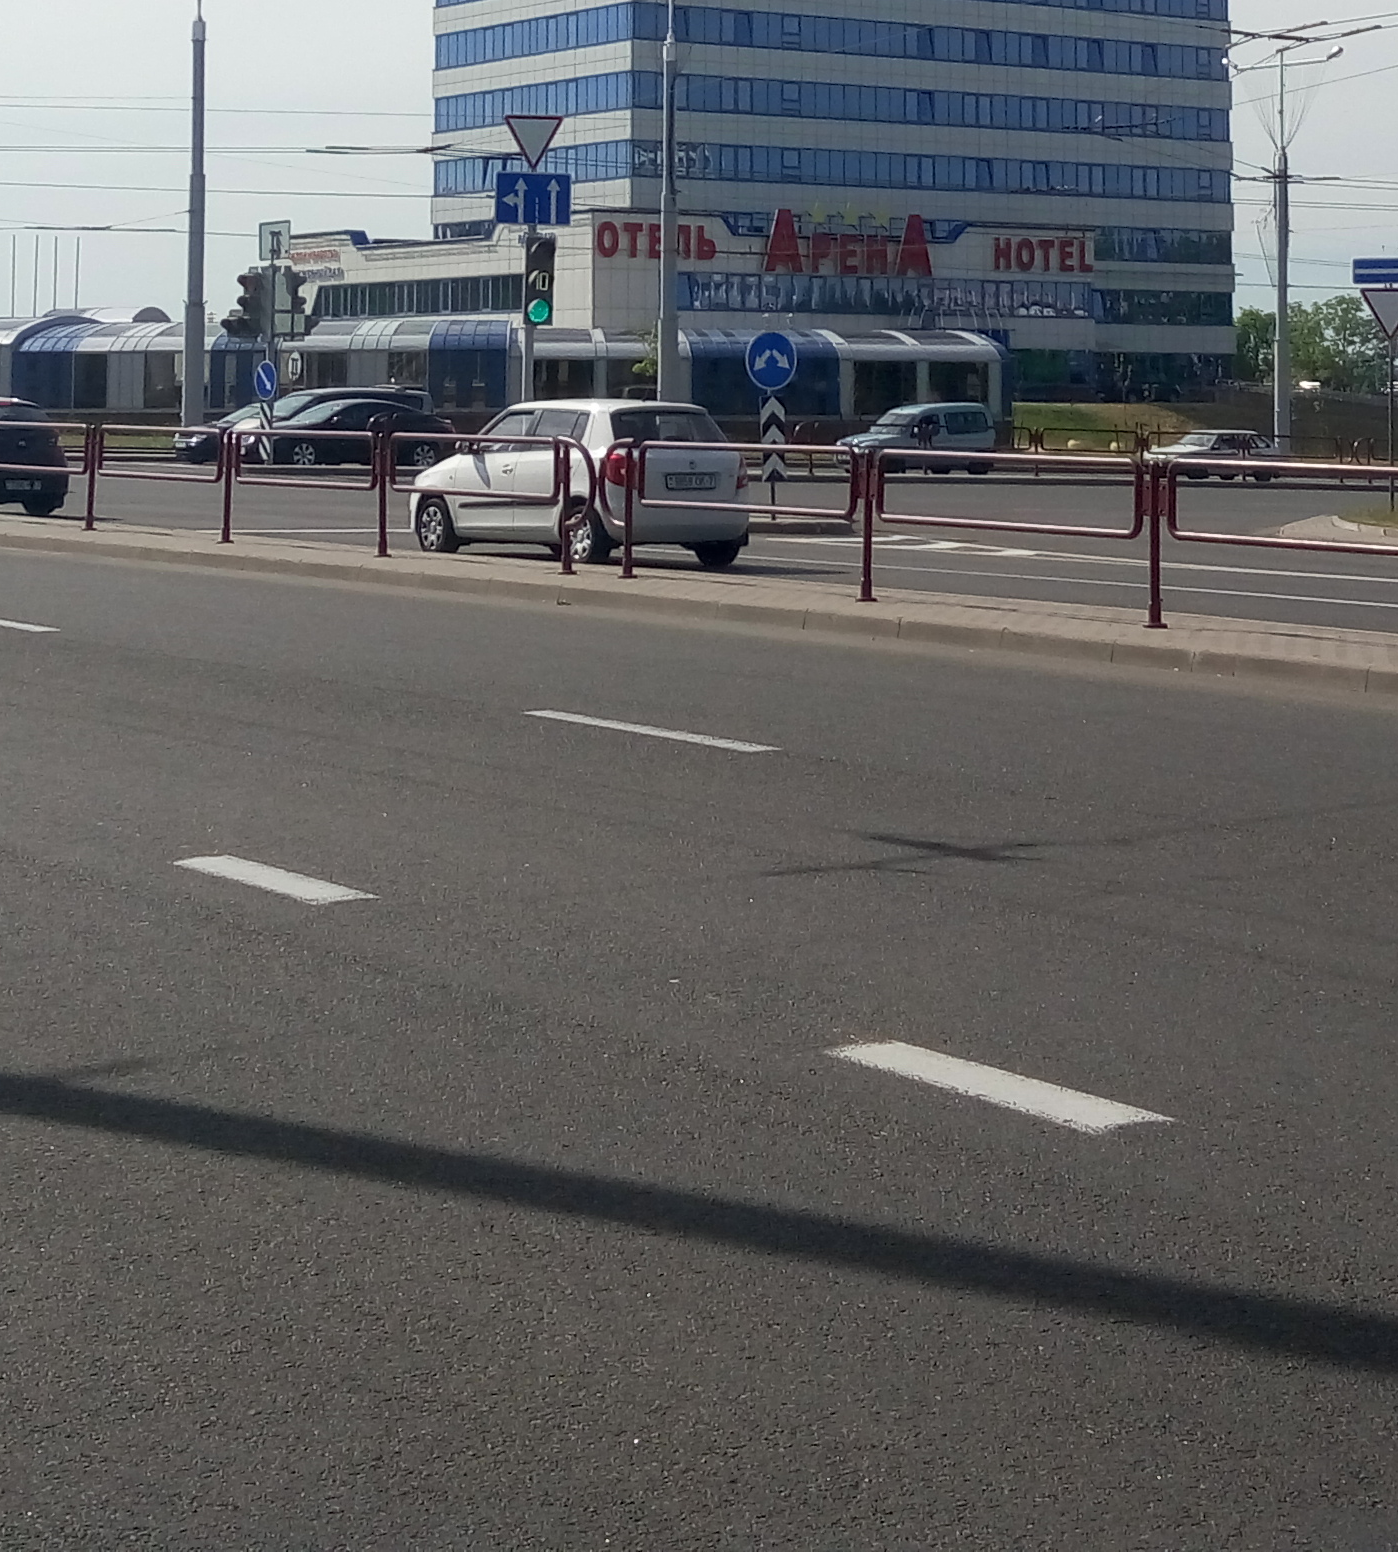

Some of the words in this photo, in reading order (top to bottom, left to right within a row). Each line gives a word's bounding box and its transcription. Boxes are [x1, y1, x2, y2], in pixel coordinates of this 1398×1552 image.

[597, 221, 717, 260] ОТЕЛЬ
[993, 236, 1094, 273] HOTEL
[536, 272, 549, 290] 10
